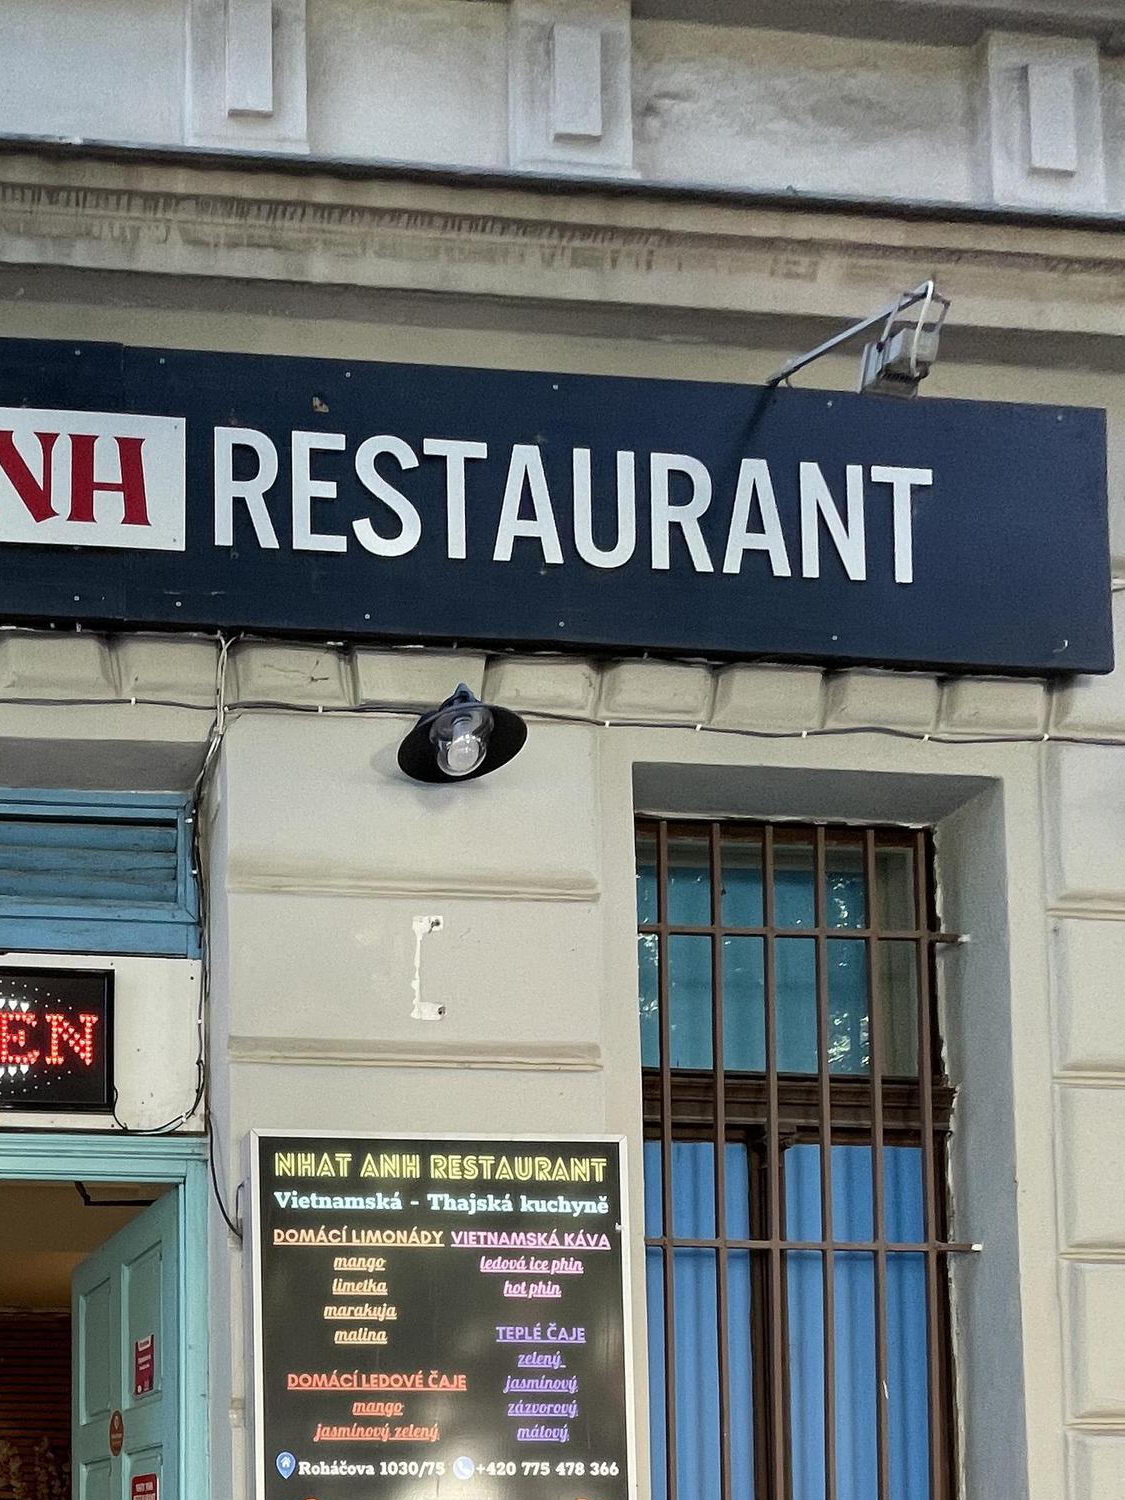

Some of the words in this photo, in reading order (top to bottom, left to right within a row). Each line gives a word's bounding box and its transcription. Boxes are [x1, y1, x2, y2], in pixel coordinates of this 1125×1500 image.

[213, 425, 934, 584] RESTAURANT
[274, 1152, 353, 1177] NHAT
[360, 1153, 421, 1179] ANH
[430, 1154, 607, 1183] RESTAURANT
[274, 1190, 403, 1210] Vietnamská
[427, 1193, 514, 1216] Thajská
[520, 1195, 610, 1218] kuchyně
[273, 1225, 348, 1244] DOMÁCÍ
[352, 1226, 444, 1245] LIMONÁDY
[450, 1228, 561, 1247] VIETNAMSKÁ
[564, 1228, 611, 1248] KÁVA
[333, 1255, 387, 1273] mango
[480, 1256, 527, 1271] ledová
[530, 1256, 550, 1271] ice
[550, 1257, 584, 1275] phin
[332, 1278, 388, 1294] limetka
[503, 1280, 528, 1295] hot
[528, 1281, 562, 1298] phin
[324, 1303, 398, 1321] marakuja
[334, 1328, 388, 1343] malina
[496, 1322, 542, 1340] TEPLÉ
[546, 1322, 586, 1341] ČAJE
[518, 1351, 563, 1369] zelený
[287, 1369, 359, 1388] DOMÁCÍ
[361, 1370, 424, 1388] LEDOVÉ
[428, 1370, 467, 1389] ČAJE
[503, 1375, 578, 1393] jasmínový
[352, 1400, 405, 1417] mango
[508, 1400, 578, 1418] zázvorový
[313, 1423, 391, 1442] jasmínový
[394, 1423, 440, 1442] zelený
[517, 1424, 570, 1443] mátový
[298, 1460, 375, 1476] Roháčova
[379, 1461, 446, 1478] 1030/75
[475, 1462, 517, 1476] +420
[521, 1462, 551, 1476] 775
[555, 1462, 586, 1476] 478
[589, 1462, 620, 1476] 366
